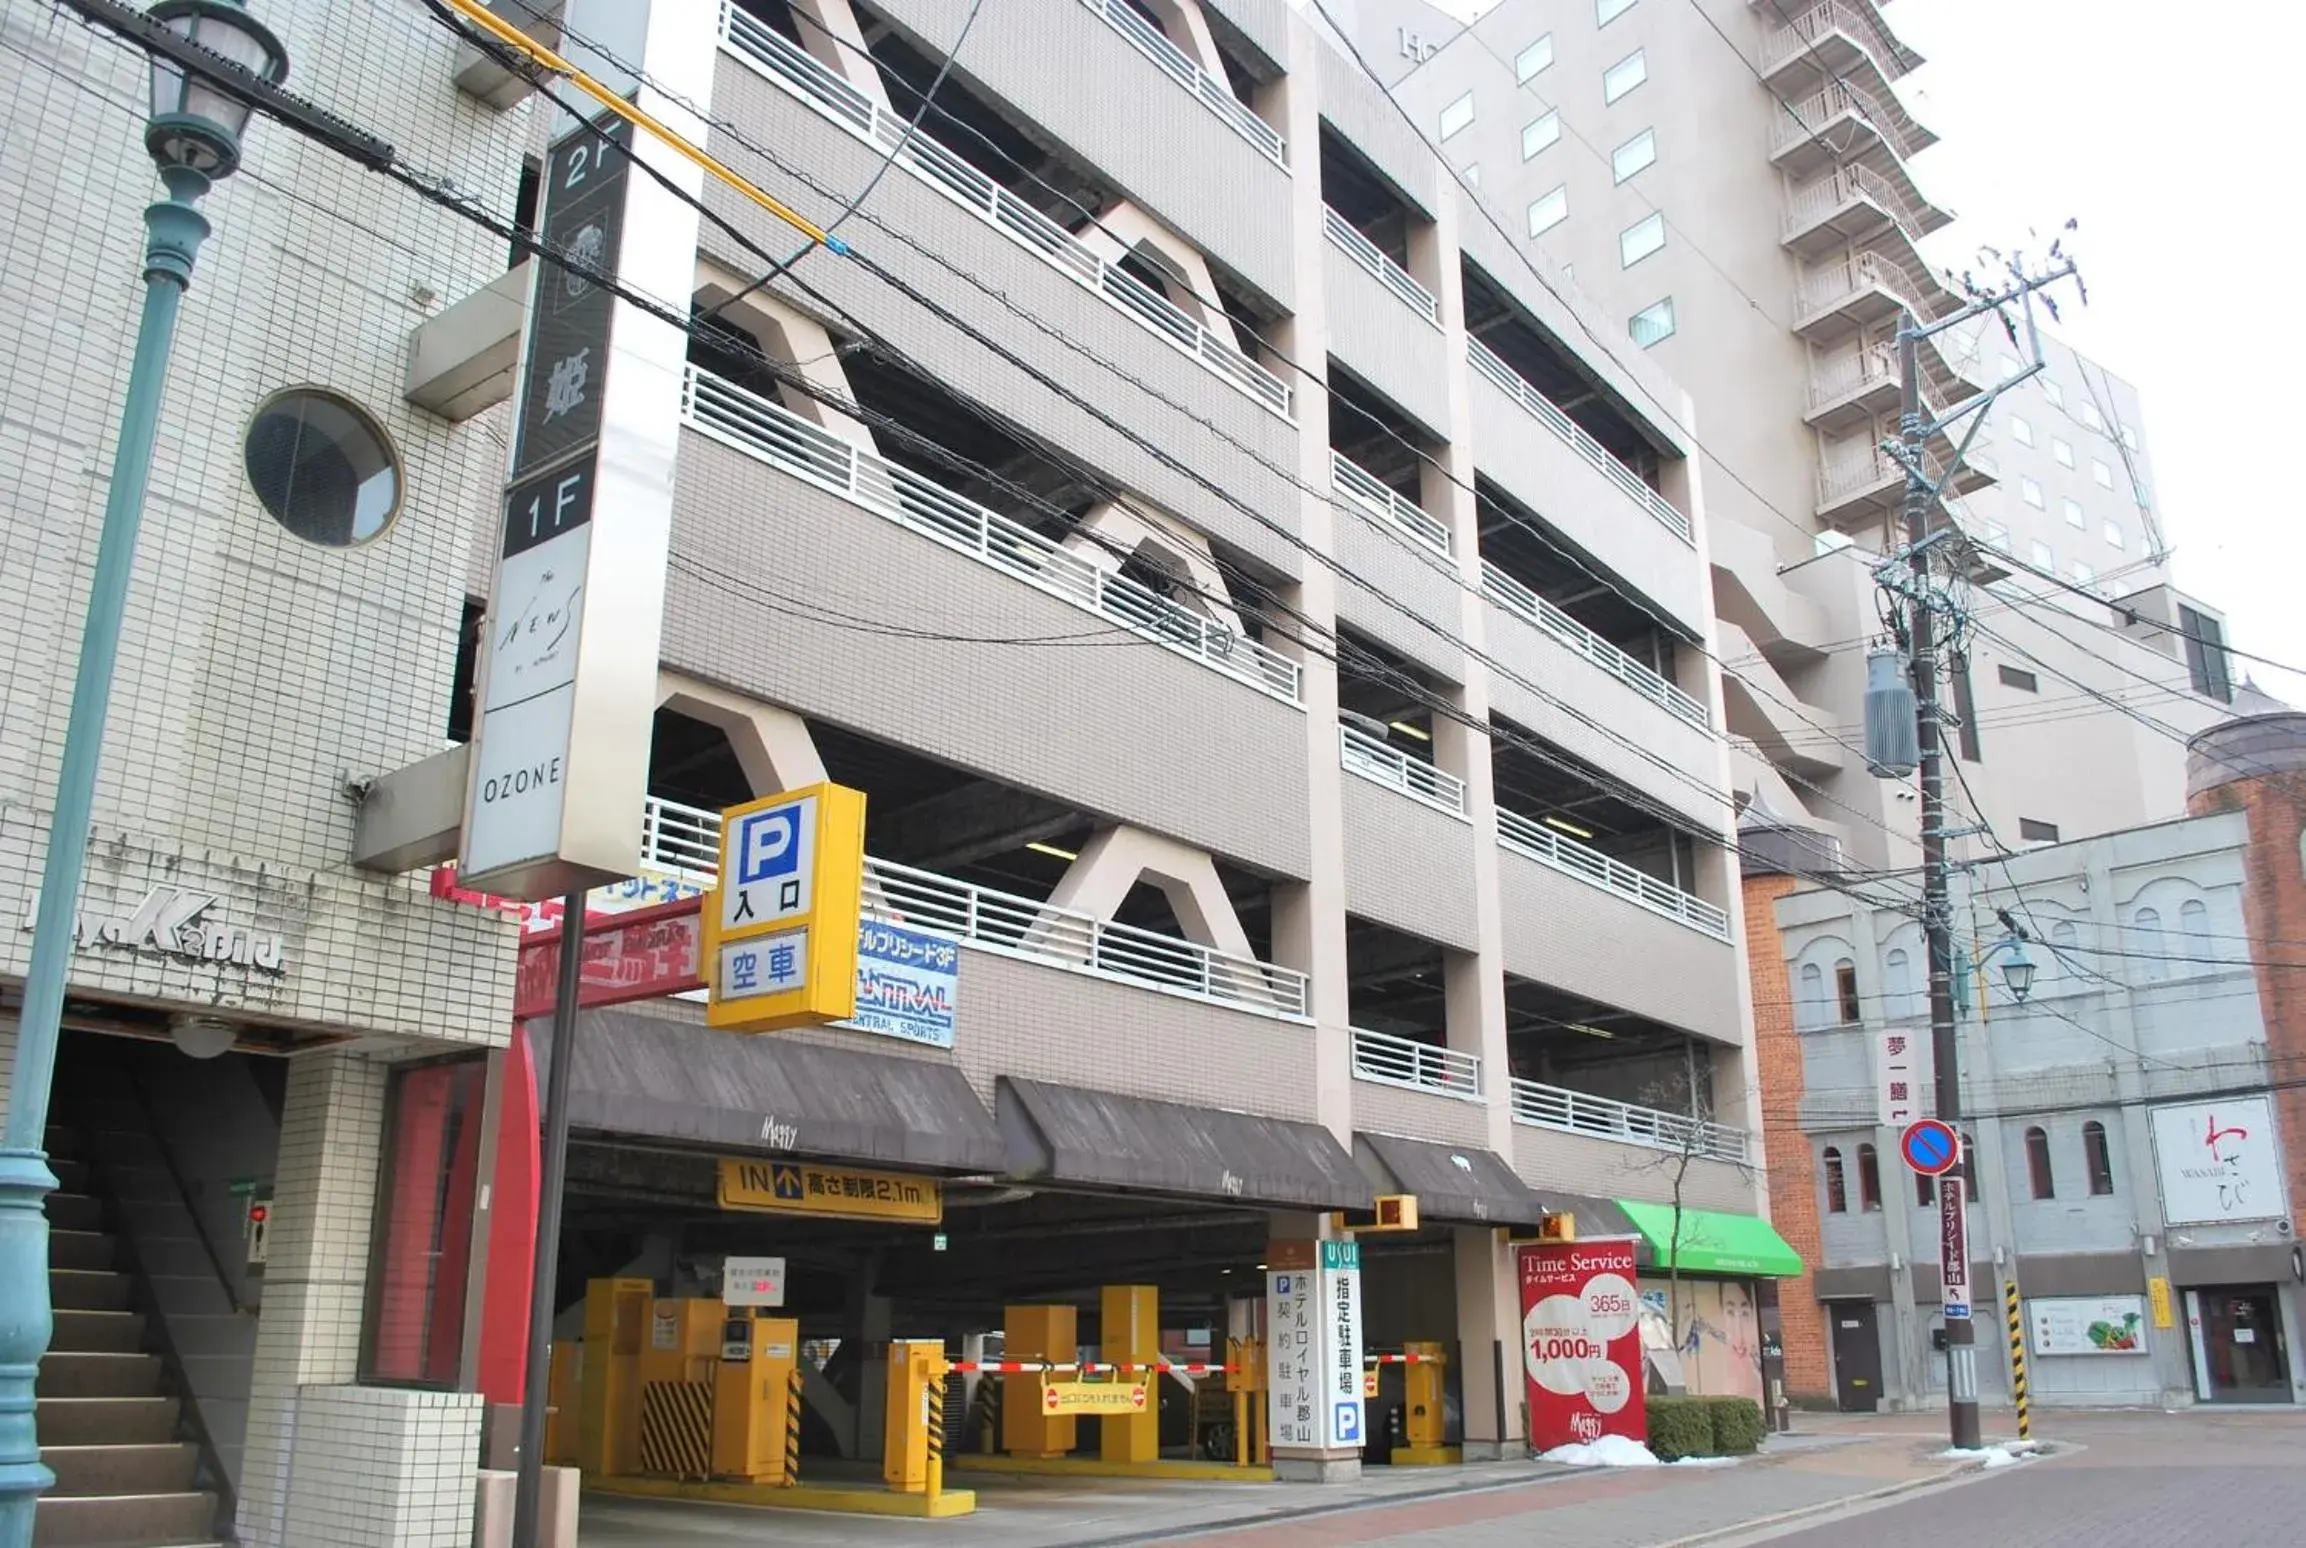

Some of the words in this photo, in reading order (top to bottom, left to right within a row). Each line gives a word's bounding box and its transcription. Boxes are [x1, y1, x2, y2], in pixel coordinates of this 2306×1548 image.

[528, 473, 580, 538] 1F
[484, 756, 560, 803] OZONE
[733, 879, 800, 923] 入口
[732, 943, 796, 990] 空車
[740, 1165, 769, 1192] IN
[806, 1172, 920, 1205] 高さ制限2.1m
[1522, 1254, 1567, 1273] Time
[1570, 1251, 1633, 1272] Service
[1336, 1277, 1352, 1395] 指定駐車場
[1530, 1338, 1601, 1364] 1,000円
